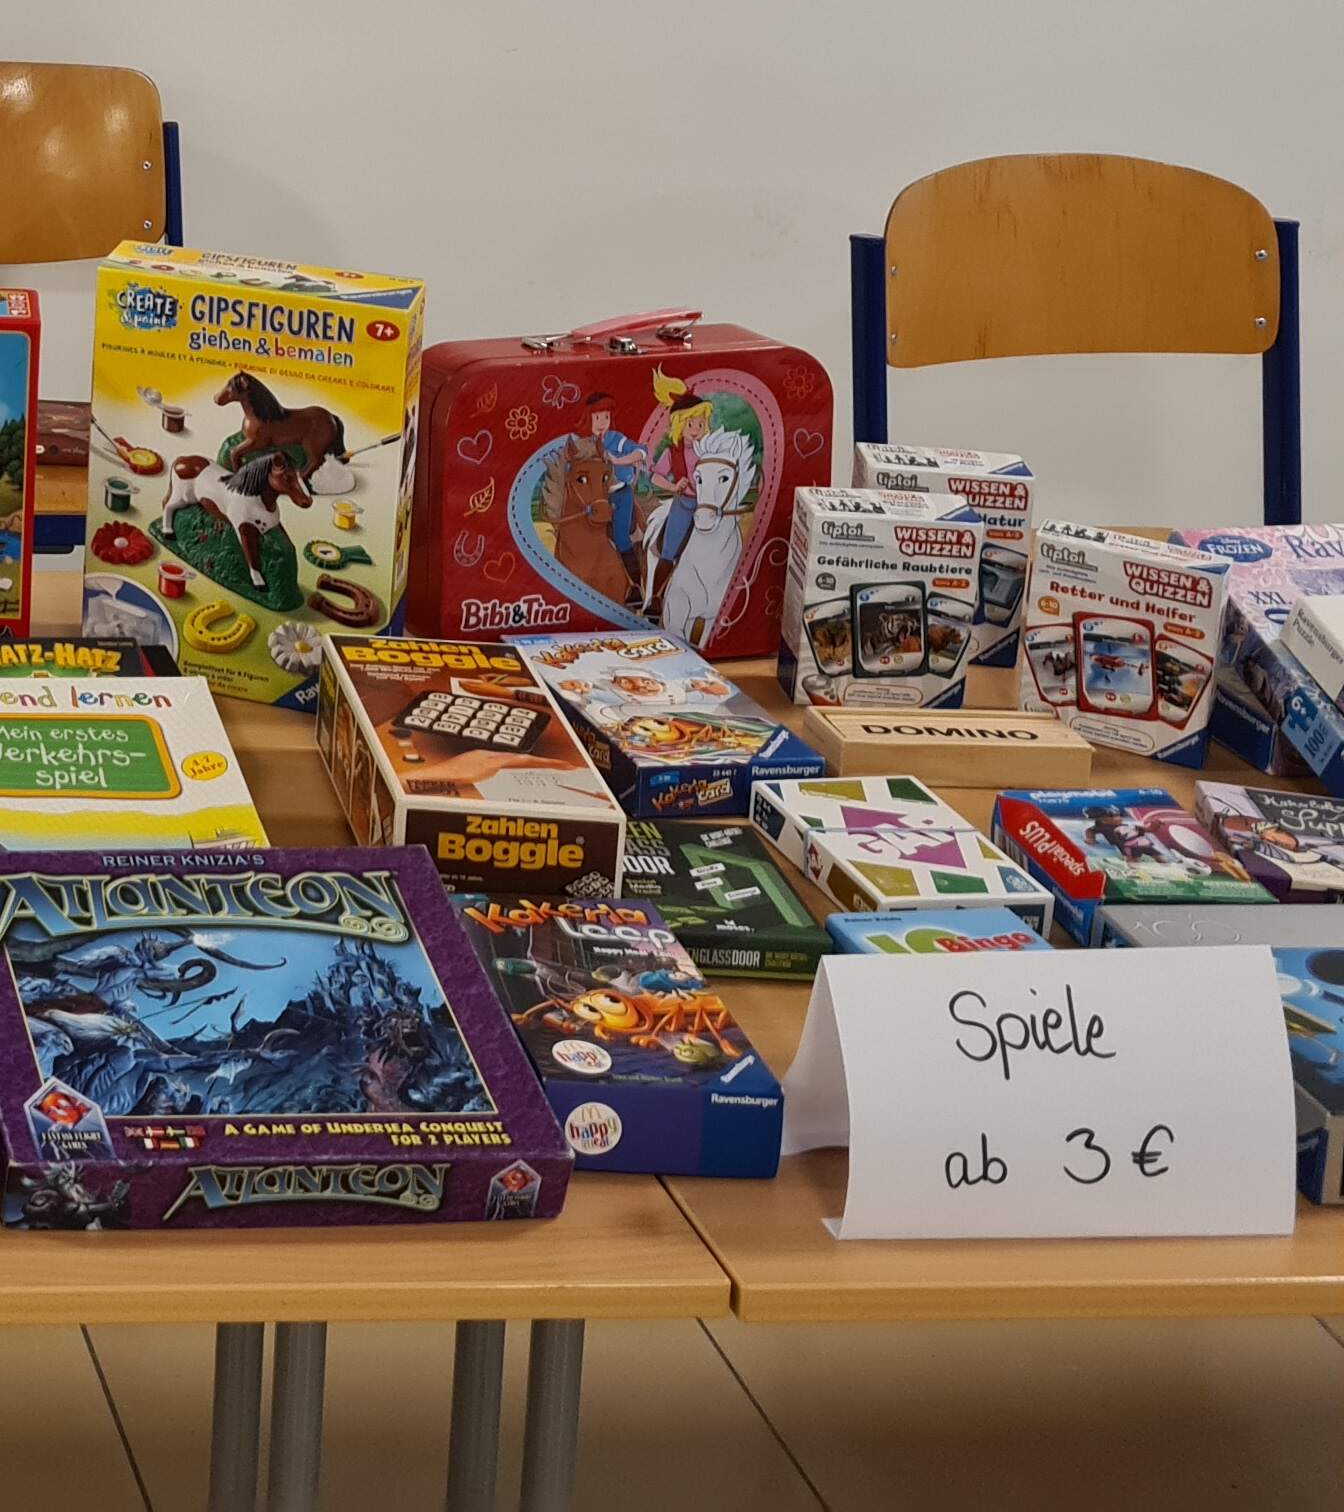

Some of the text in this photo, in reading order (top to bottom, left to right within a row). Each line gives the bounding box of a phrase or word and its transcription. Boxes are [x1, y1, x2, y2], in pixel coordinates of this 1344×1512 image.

[116, 288, 175, 316] CREATE
[190, 294, 356, 344] GIPSFIGUREN
[189, 328, 354, 367] gießen & bemalen
[949, 478, 1011, 496] WISSEN
[895, 527, 958, 543] WISSEN
[901, 543, 973, 558] QUIZZEN
[1207, 543, 1263, 555] FROZEN
[816, 555, 973, 576] Gefährliche Raubtiere
[1124, 562, 1193, 589] WISSEN
[1049, 581, 1197, 623] Retter und Helfer
[1129, 578, 1210, 607] QUIZZEN
[460, 594, 570, 632] Bibi&Tina
[368, 638, 482, 655] Zahlen
[341, 645, 522, 672] Boggle
[70, 685, 173, 708] lernen
[48, 725, 129, 742] erstes
[862, 722, 1040, 742] DOMINO
[35, 766, 108, 790] spiel
[188, 761, 225, 779] Jahre
[751, 765, 821, 777] Ravensburger
[465, 815, 559, 838] Zahlen
[102, 854, 265, 868] REINER KNIZIA'S
[437, 832, 585, 870] Boggle
[557, 916, 676, 948] Loop
[948, 983, 1117, 1081] Spiele
[711, 1094, 779, 1108] Ravensburger
[224, 1120, 505, 1136] A GAME OF UNDERSEA CONQUEST
[392, 1132, 512, 1146] FOR 2 PLAYERS
[944, 1123, 1175, 1189] ab 3 €
